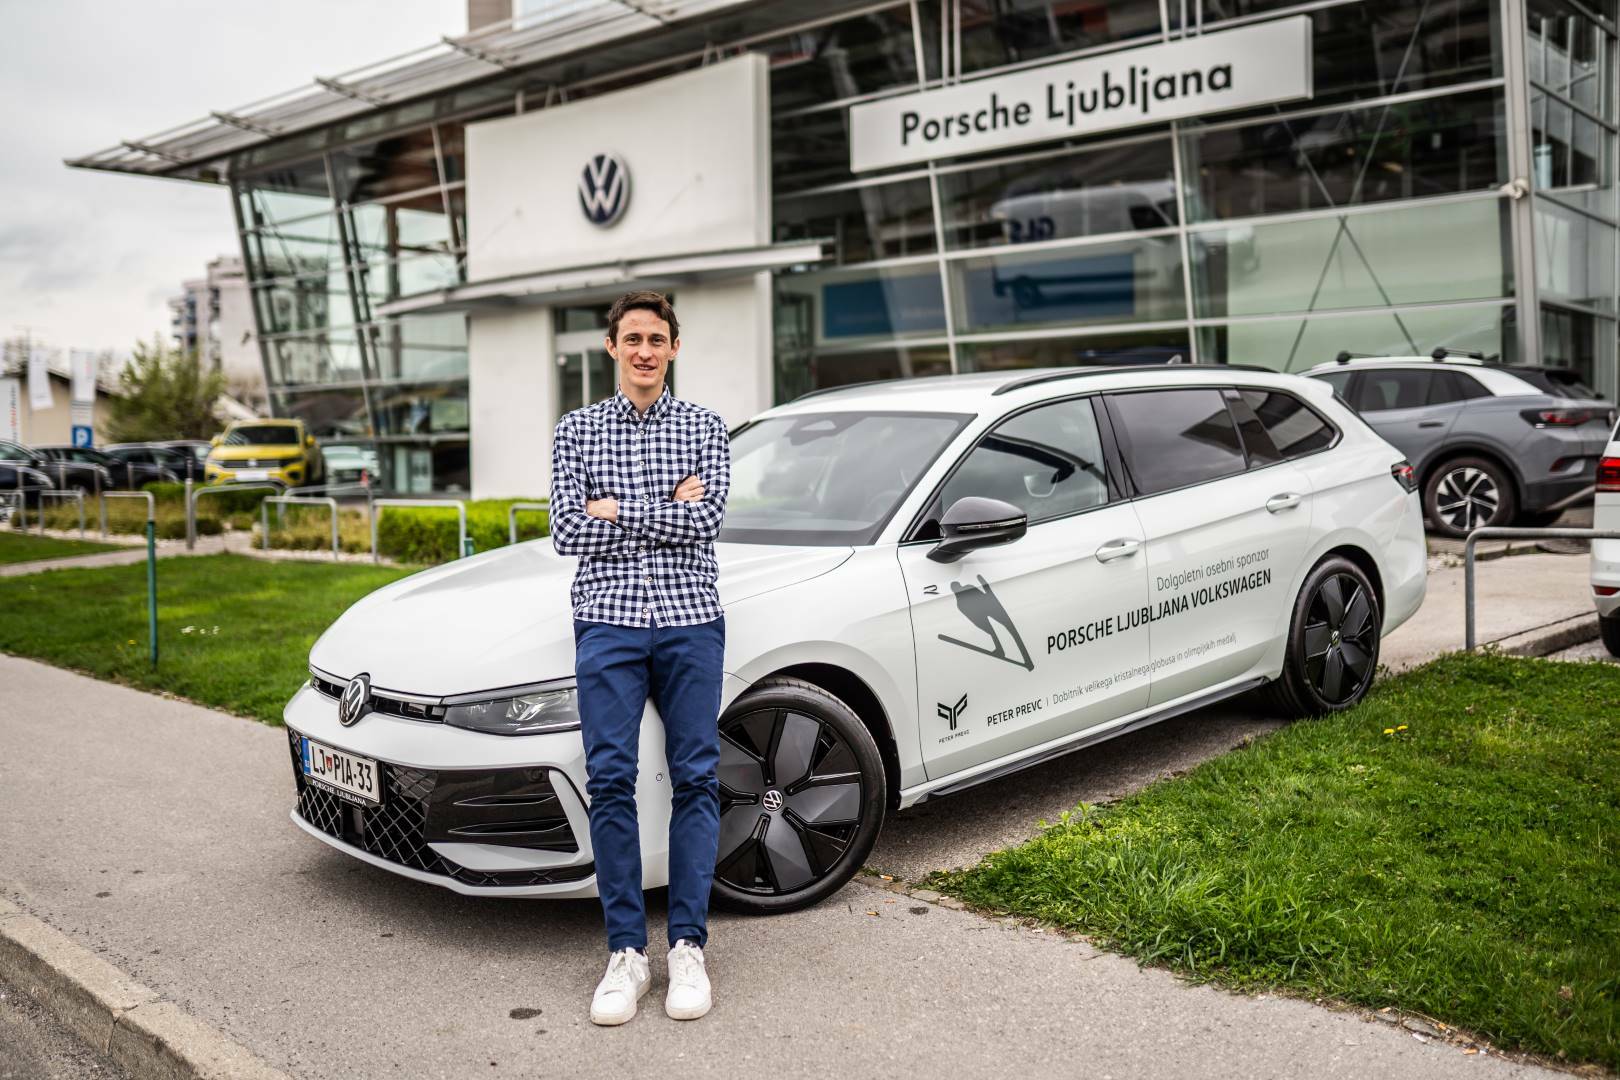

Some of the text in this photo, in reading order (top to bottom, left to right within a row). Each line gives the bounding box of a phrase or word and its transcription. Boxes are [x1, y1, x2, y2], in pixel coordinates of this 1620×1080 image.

[902, 65, 1232, 145] Porsche Ljubljana
[1157, 548, 1270, 591] Dolgoletni osebni sponzor
[1047, 568, 1271, 654] PORSCHE LJUBLJANA VOLKSWAGEN
[987, 709, 1014, 727] PETER
[1016, 699, 1043, 718] PREVC
[1053, 685, 1084, 705] Dobitnik
[1084, 677, 1113, 694] velikega
[1114, 664, 1150, 682] kristalnega
[1150, 656, 1176, 672] globusa
[938, 735, 954, 745] PETER
[332, 753, 373, 793] PIA-33
